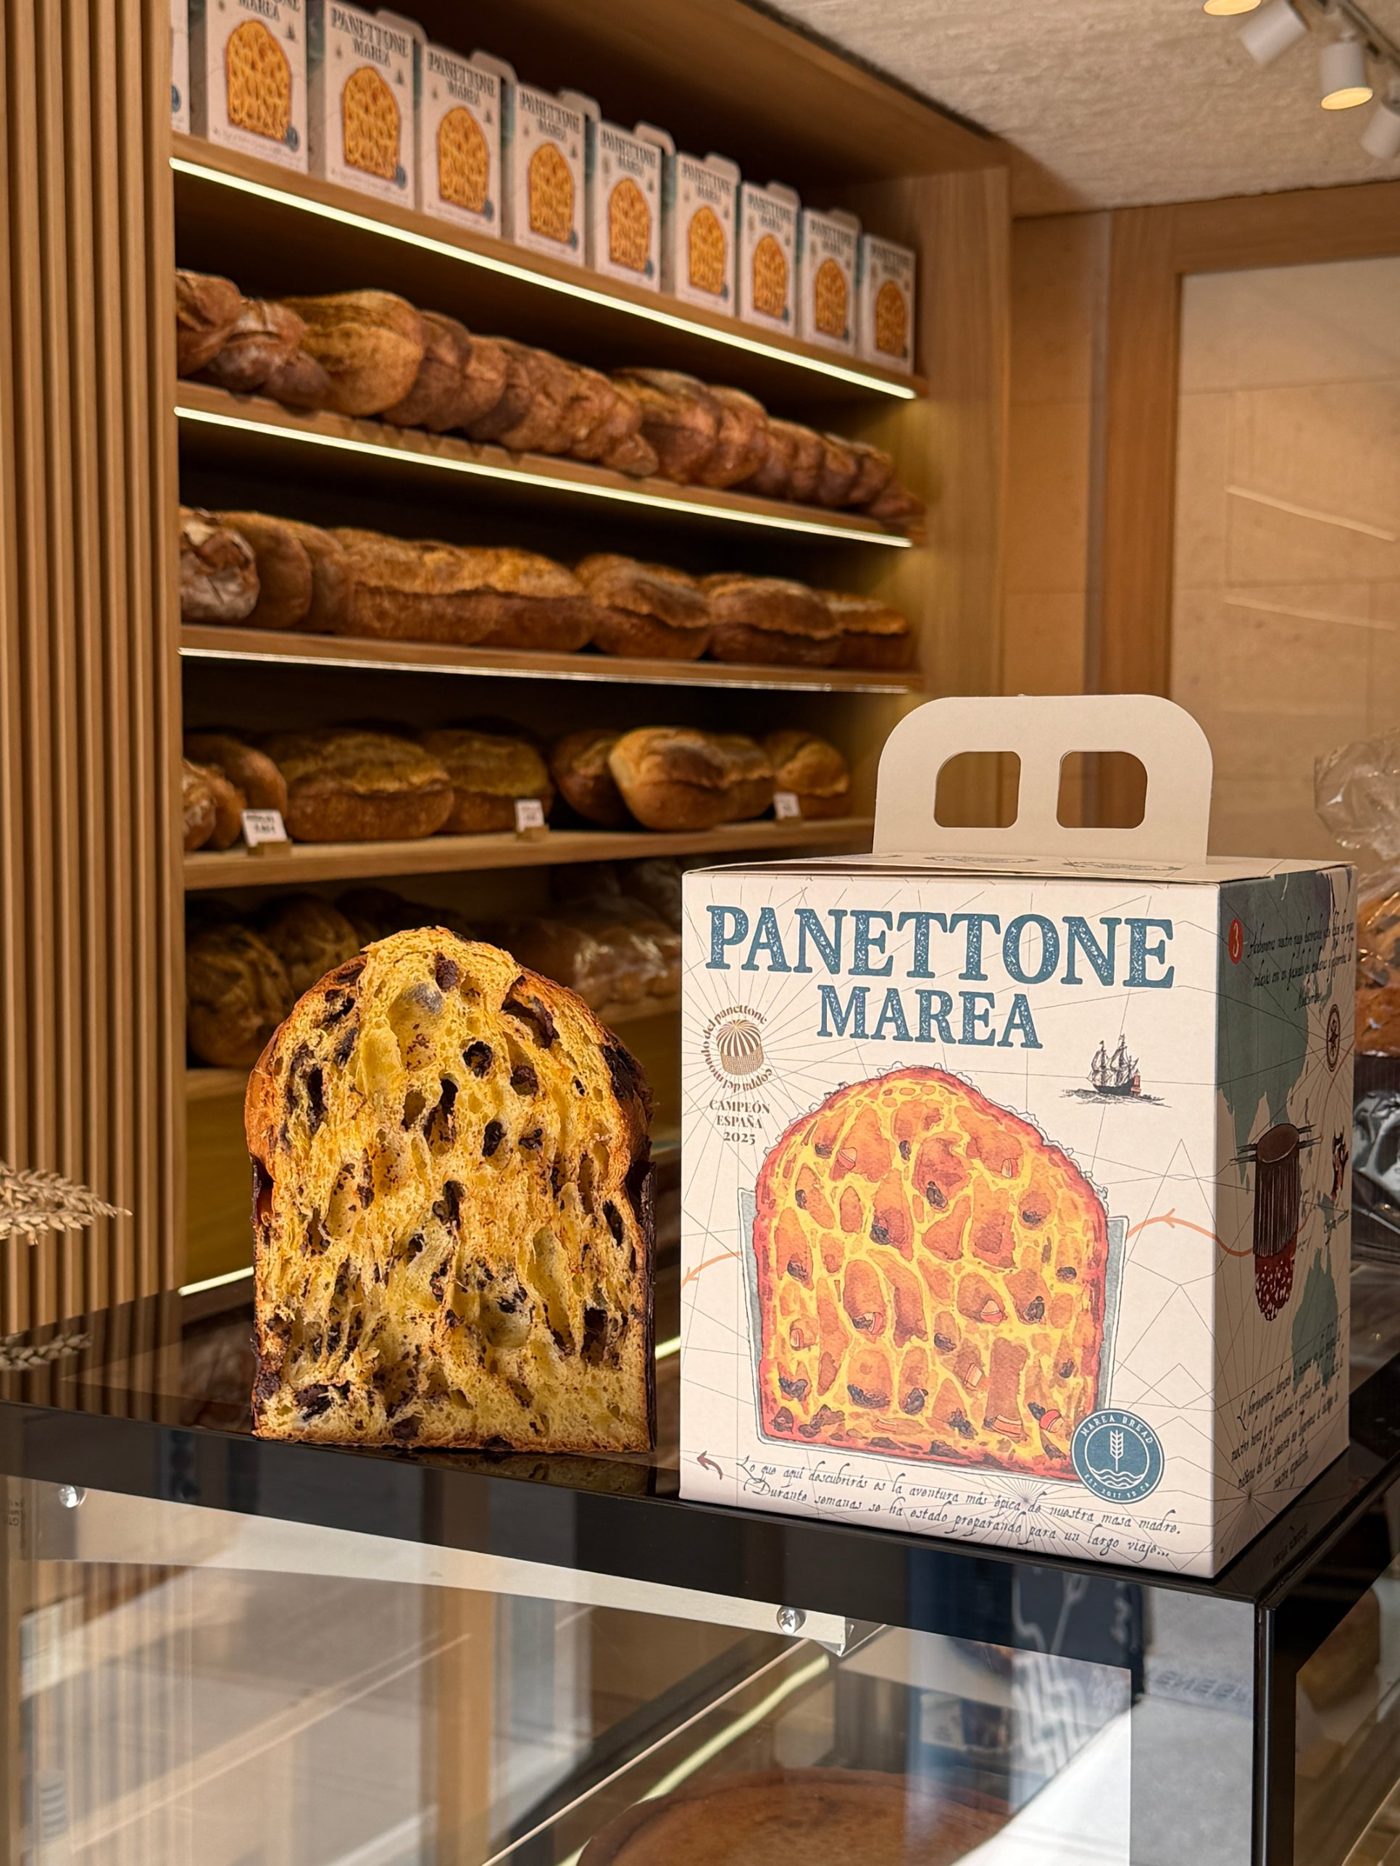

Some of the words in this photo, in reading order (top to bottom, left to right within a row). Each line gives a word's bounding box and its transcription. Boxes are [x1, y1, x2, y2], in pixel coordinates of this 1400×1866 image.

[331, 7, 409, 59] PANETTONE
[706, 904, 1175, 989] PANETTONE
[1233, 921, 1240, 958] 3
[703, 1018, 717, 1041] del
[714, 1004, 767, 1026] panettone
[817, 984, 1044, 1050] MAREA
[701, 1041, 724, 1083] mondo
[722, 1079, 741, 1094] del
[742, 1068, 773, 1092] coppa
[709, 1099, 771, 1115] CAMPEÓN
[716, 1114, 763, 1130] ESPAÑA
[723, 1131, 756, 1146] 2025
[1080, 1414, 1116, 1438] MAREA
[1122, 1415, 1154, 1445] BREAD
[761, 1465, 777, 1482] que
[781, 1466, 804, 1488] aquí
[808, 1460, 868, 1489] descubrirás
[873, 1481, 886, 1492] es
[892, 1472, 906, 1495] la
[909, 1485, 960, 1504] aventura
[965, 1491, 987, 1505] más
[989, 1494, 1022, 1518] épica
[1027, 1491, 1049, 1513] de
[1049, 1507, 1095, 1523] nuestra
[1101, 1515, 1132, 1528] masa
[1138, 1508, 1181, 1535] madre.
[743, 1476, 808, 1503] Durante
[814, 1494, 863, 1512] semanas
[868, 1502, 882, 1513] se
[888, 1496, 907, 1517] ha
[909, 1501, 954, 1524] estado
[944, 1510, 1027, 1538] preparando
[1017, 1525, 1057, 1546] para
[1064, 1530, 1081, 1542] un
[1087, 1523, 1120, 1556] largo
